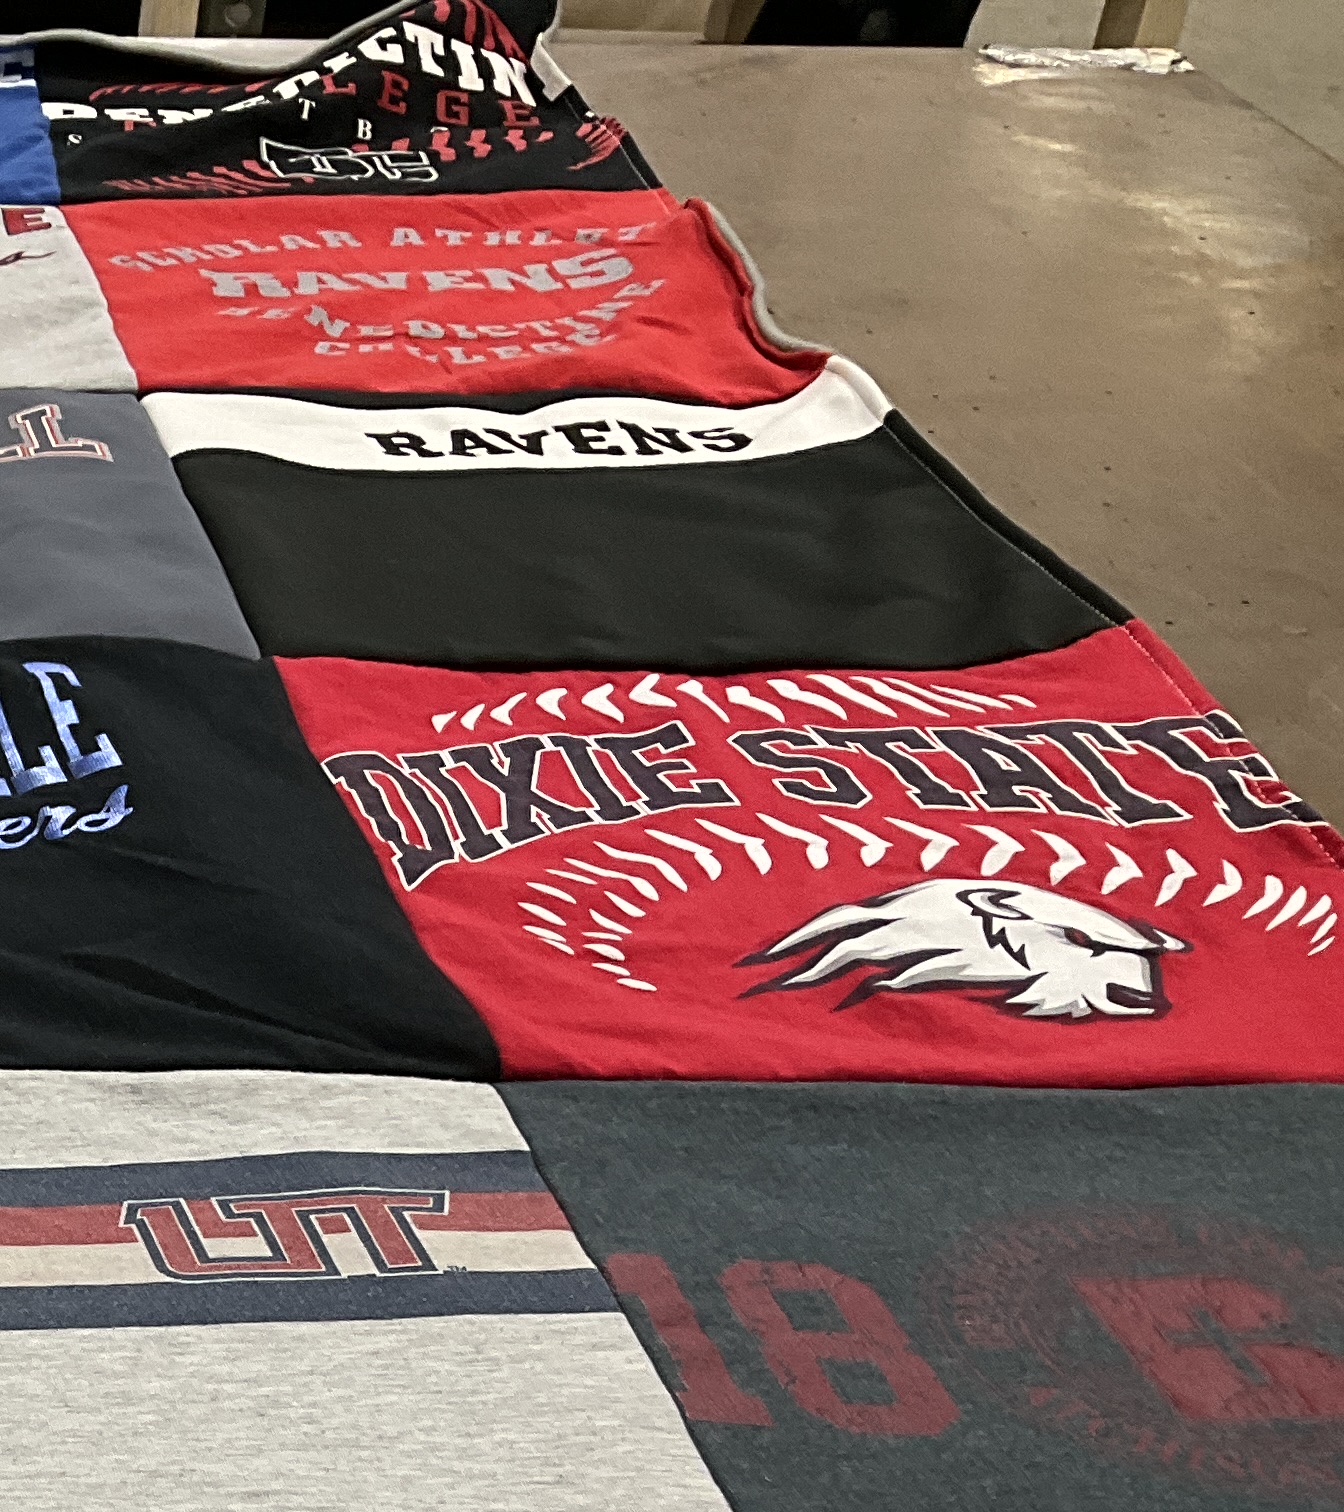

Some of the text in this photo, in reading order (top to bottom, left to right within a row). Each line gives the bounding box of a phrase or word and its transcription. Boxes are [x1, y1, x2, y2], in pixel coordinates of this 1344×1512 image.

[109, 228, 363, 272] SCHOLAR
[199, 247, 635, 298] RAVENS
[365, 418, 753, 459] RAVENS
[320, 708, 1332, 892] DIXIE STATE
